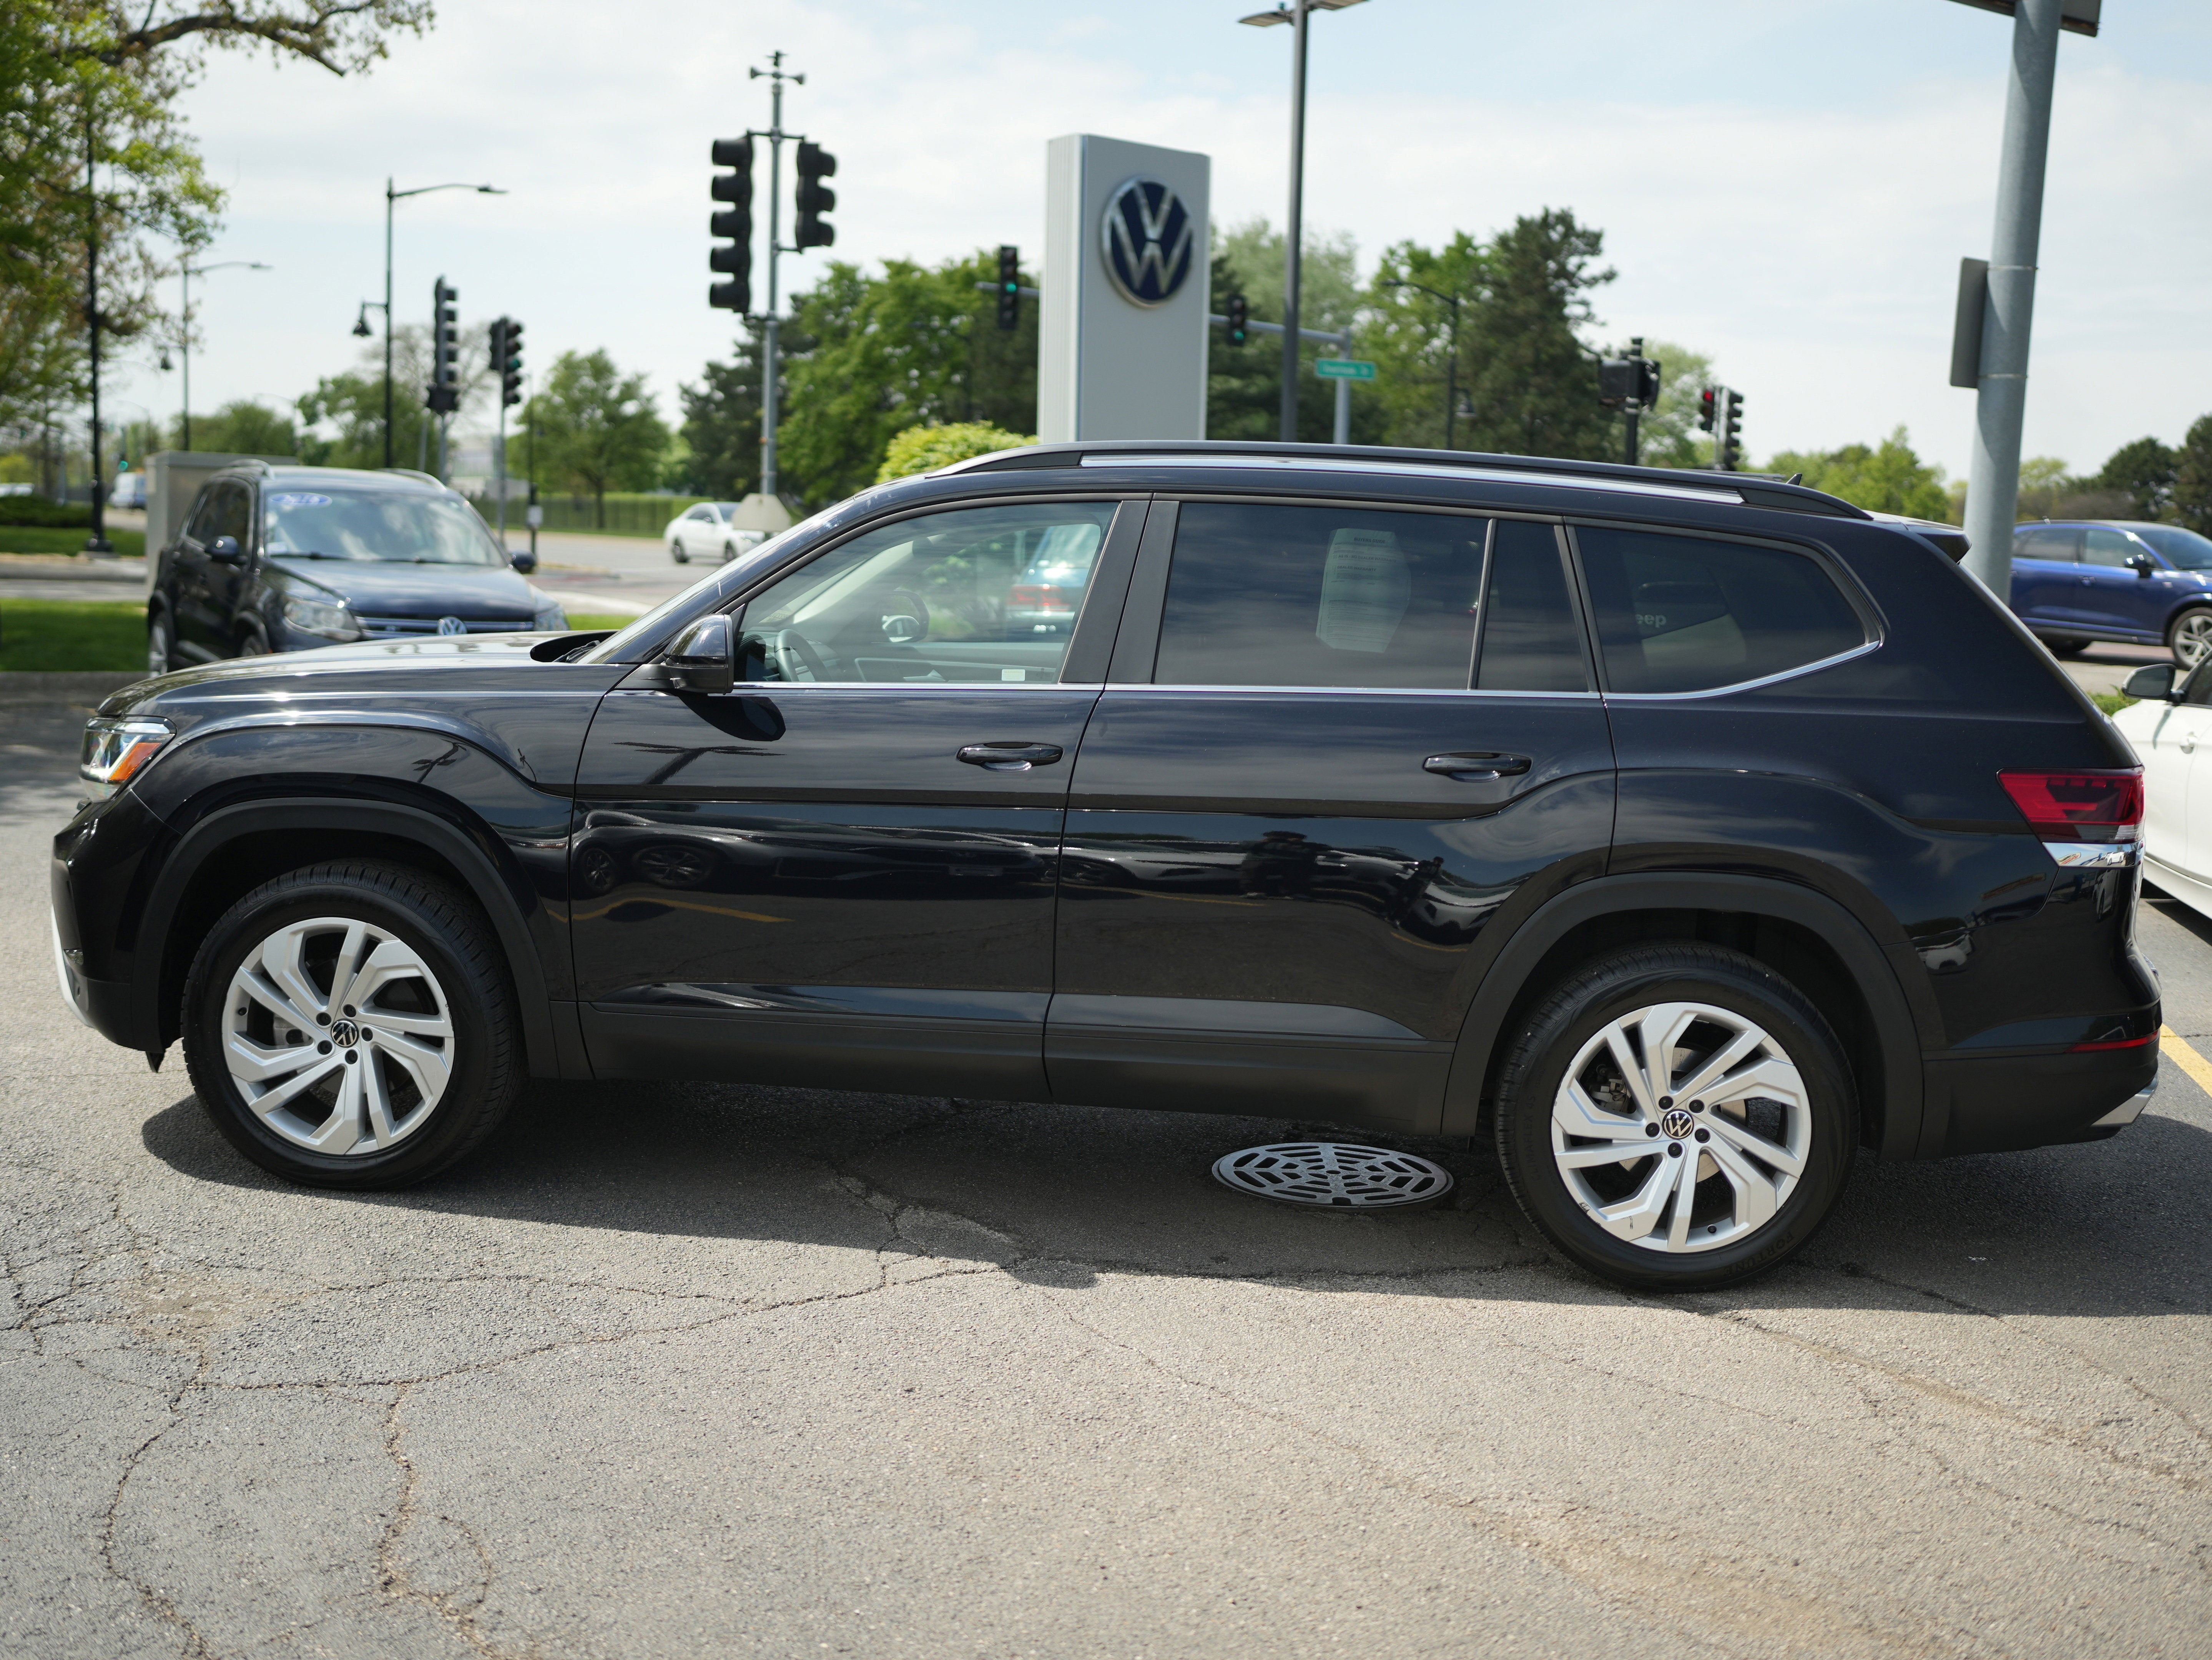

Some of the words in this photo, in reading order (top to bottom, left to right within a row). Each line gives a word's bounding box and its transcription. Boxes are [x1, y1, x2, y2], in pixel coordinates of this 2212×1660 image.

[1101, 175, 1194, 307] VW
[1636, 614, 1667, 628] eep
[331, 1020, 358, 1047] VW
[1664, 1111, 1693, 1139] VW
[1722, 1229, 1795, 1277] FORTUNE
